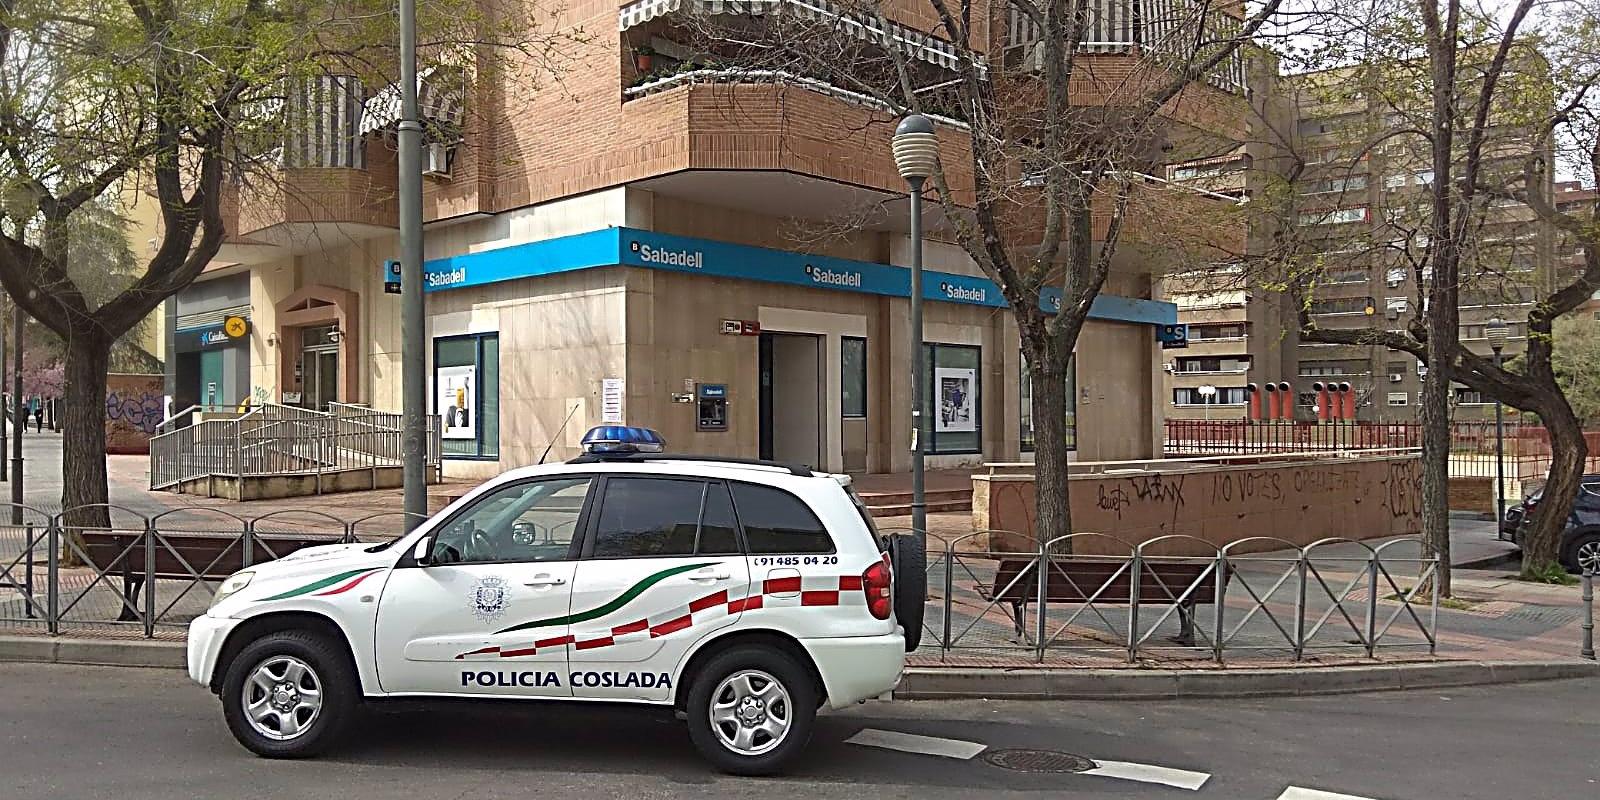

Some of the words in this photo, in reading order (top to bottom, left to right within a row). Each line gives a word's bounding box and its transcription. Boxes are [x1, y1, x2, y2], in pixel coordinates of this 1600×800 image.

[640, 244, 703, 268] Sabadell
[429, 267, 466, 287] Sabadell
[813, 267, 861, 288] Sabadell
[946, 284, 985, 302] Sabadell
[1174, 326, 1185, 340] S
[803, 556, 819, 566] 04
[822, 555, 838, 565] 20
[461, 671, 561, 687] POLICIA
[568, 671, 673, 689] COSLADA
